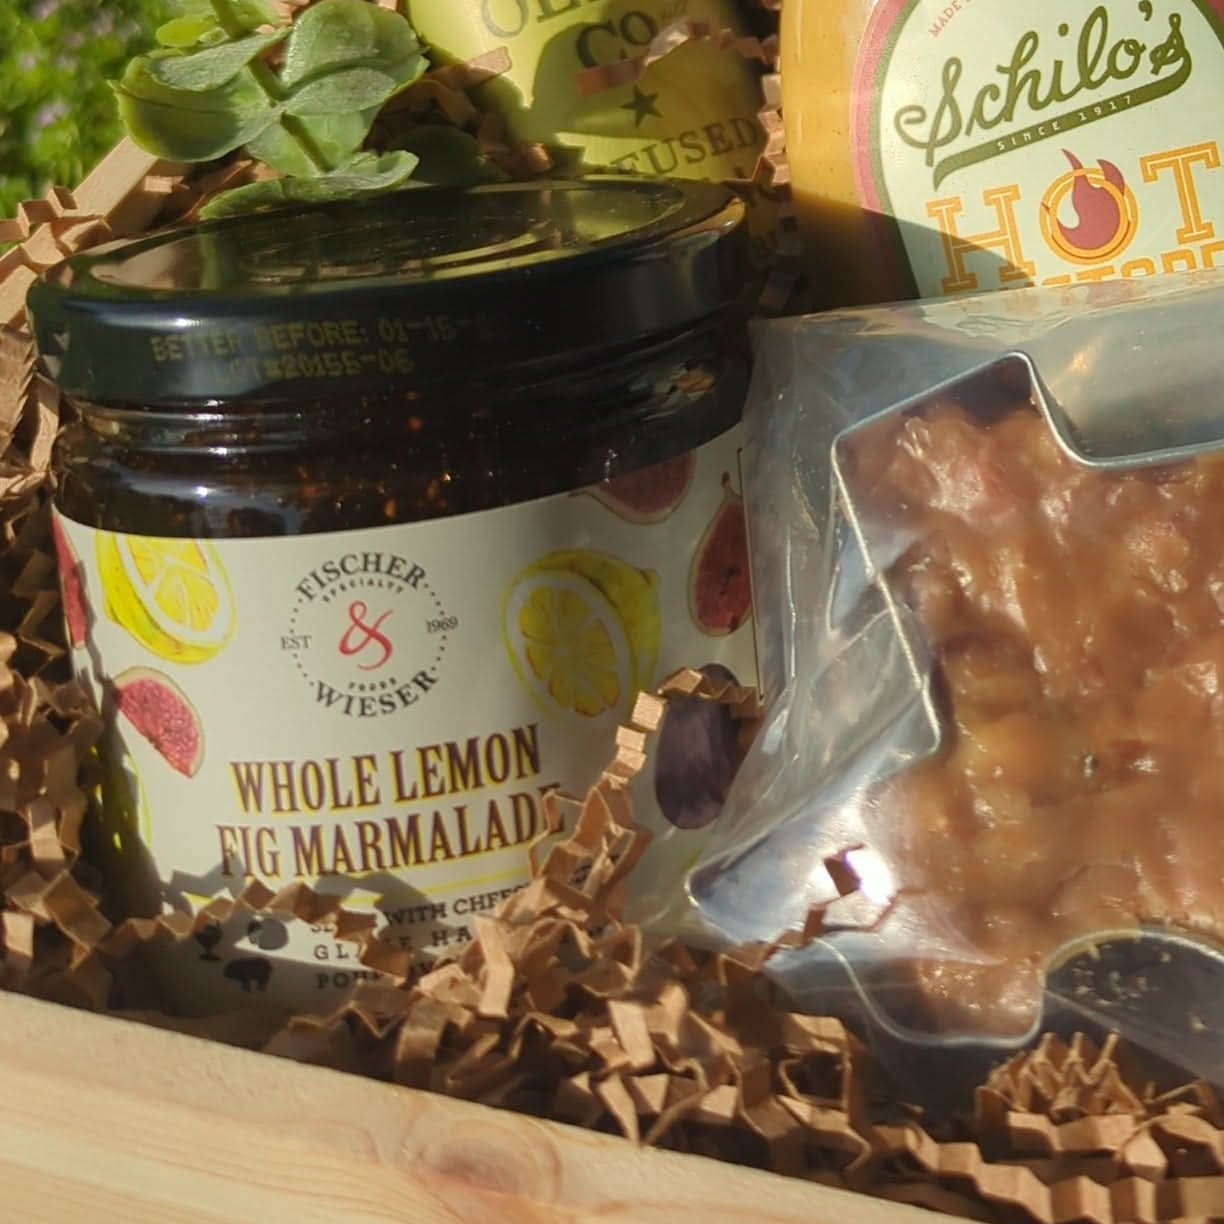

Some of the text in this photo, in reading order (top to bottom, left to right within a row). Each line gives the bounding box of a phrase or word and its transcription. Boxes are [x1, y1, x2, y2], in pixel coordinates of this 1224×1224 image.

[929, 0, 962, 38] MADE
[894, 0, 1193, 167] Schilo's
[997, 95, 1132, 151] SINCE 1917
[925, 140, 1222, 294] HOT
[295, 551, 427, 602] FISCHER
[280, 634, 312, 651] EST
[425, 615, 460, 635] 1969
[316, 670, 440, 718] WIESER
[230, 723, 543, 815] WHOLE LEMON
[216, 823, 282, 878] FIG
[385, 902, 447, 925] WITH
